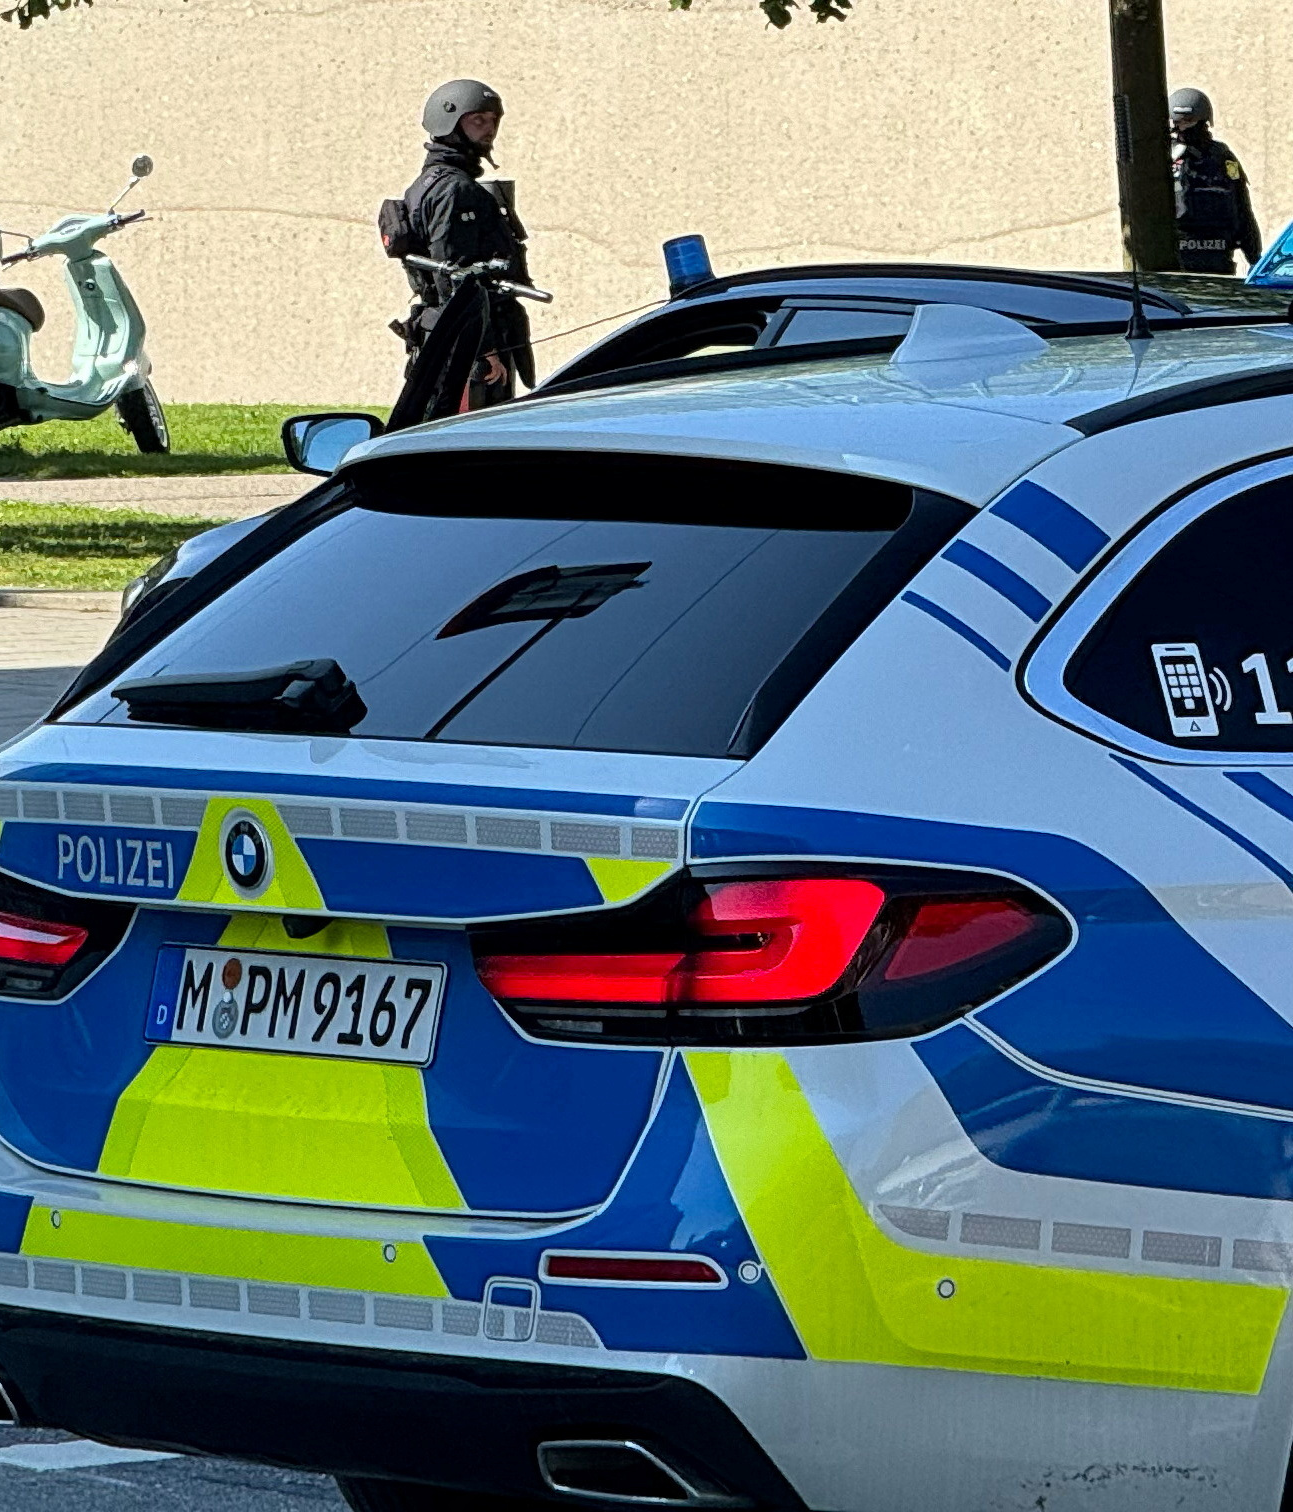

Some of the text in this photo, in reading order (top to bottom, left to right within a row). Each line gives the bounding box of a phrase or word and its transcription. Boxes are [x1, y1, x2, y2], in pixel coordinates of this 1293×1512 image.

[1179, 239, 1226, 250] POLIZEI
[57, 833, 174, 889] POLIZEI
[156, 960, 433, 1049] D M PM 9167
